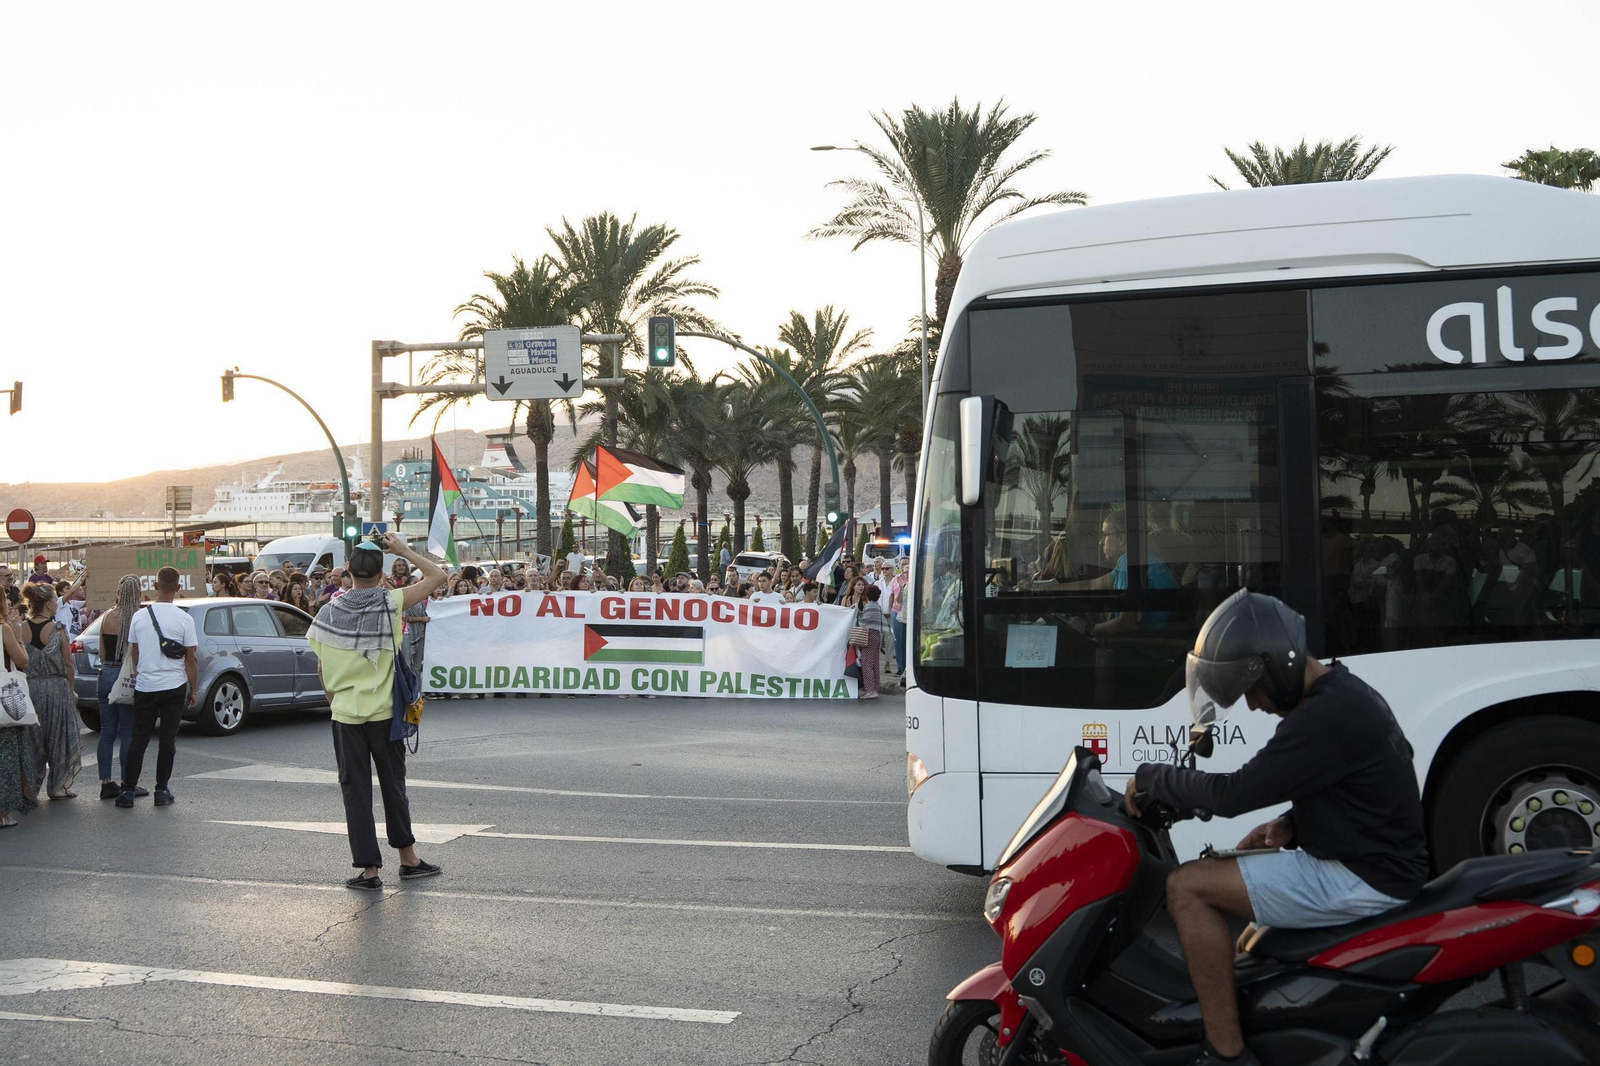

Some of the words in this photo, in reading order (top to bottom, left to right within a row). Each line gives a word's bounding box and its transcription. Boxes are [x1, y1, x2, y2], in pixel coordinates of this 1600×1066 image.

[1426, 285, 1600, 364] als
[526, 340, 556, 348] Granada
[510, 366, 557, 374] AGUADULCE
[136, 549, 198, 570] HUELGA
[140, 574, 196, 591] GEAL
[469, 594, 522, 617] NO
[536, 596, 586, 618] AL
[600, 596, 820, 630] GENOCIDIO
[429, 666, 620, 690] SOLIDARIDAD
[631, 668, 689, 692] CON
[700, 670, 850, 698] PALESTINA
[1132, 720, 1247, 745] ALMRÍA
